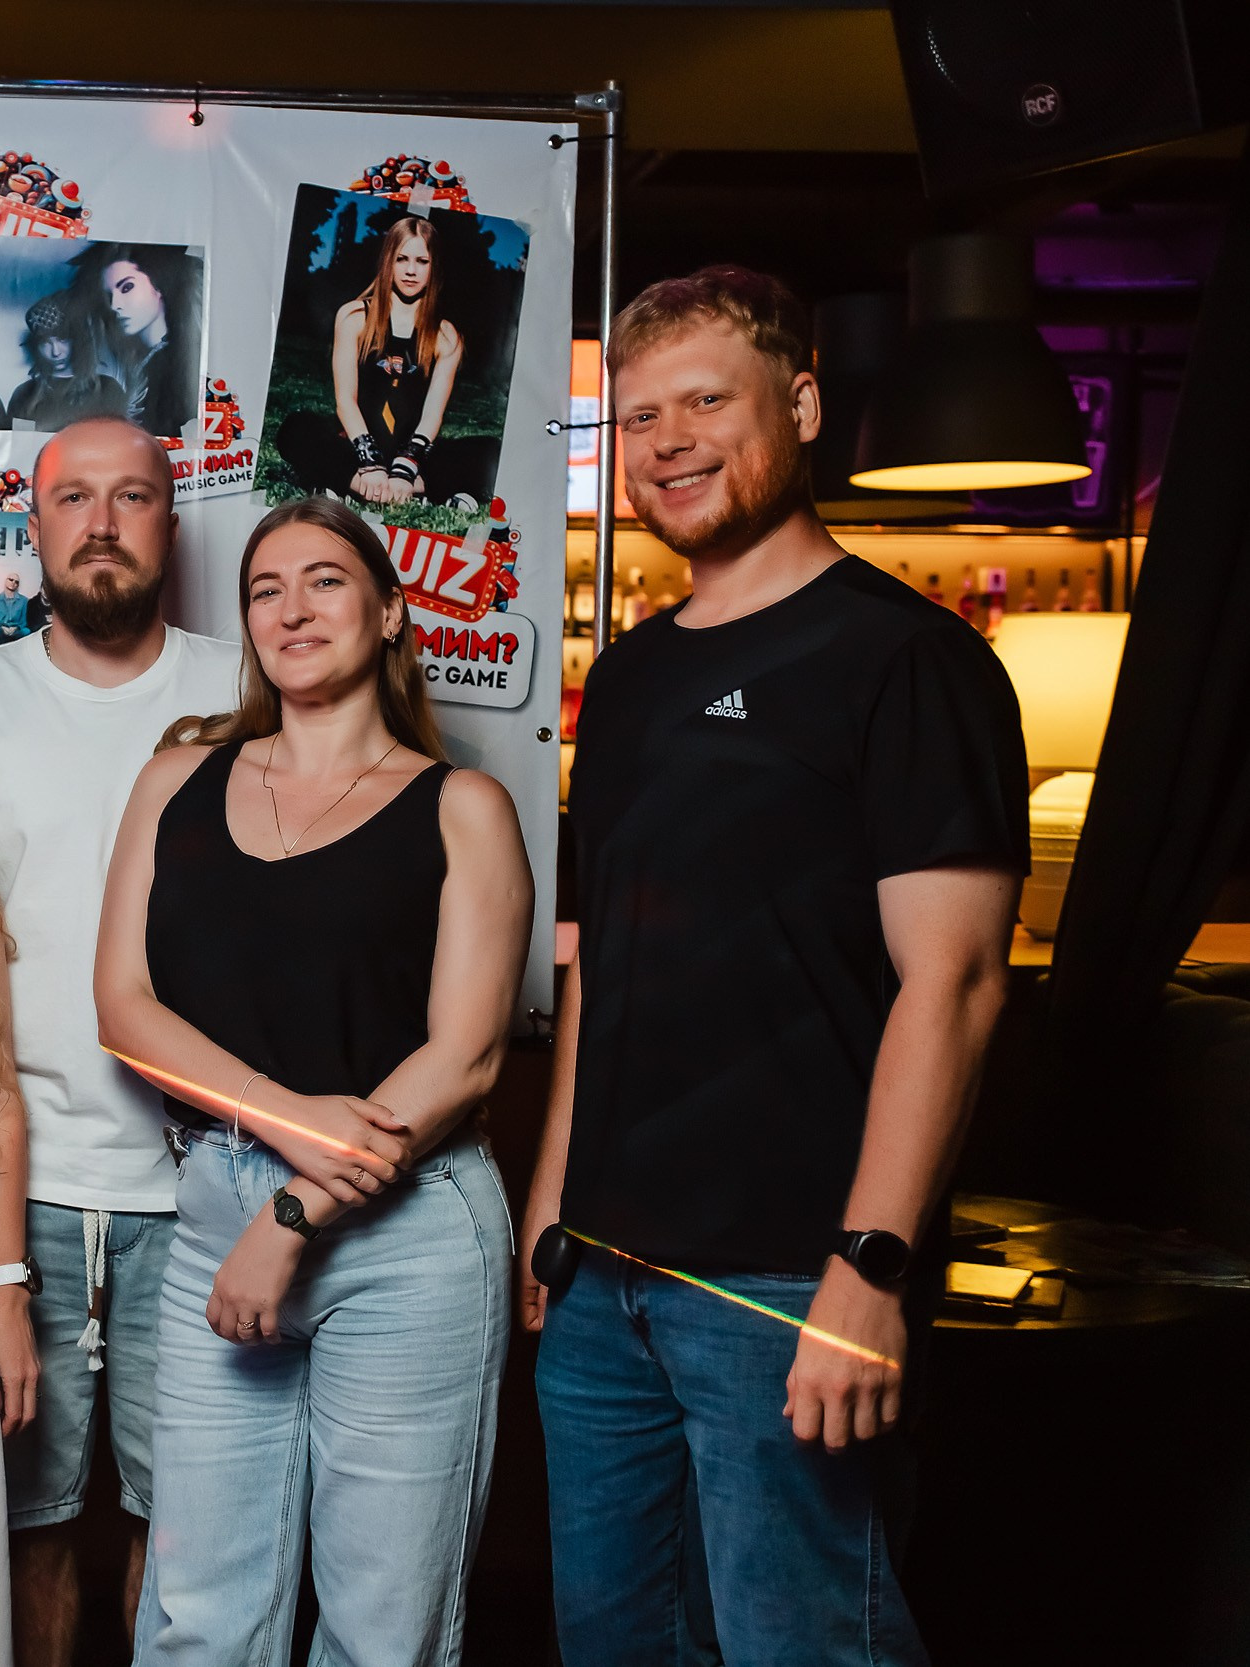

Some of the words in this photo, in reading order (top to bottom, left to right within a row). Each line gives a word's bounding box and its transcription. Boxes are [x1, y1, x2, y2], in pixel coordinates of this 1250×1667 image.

[1025, 94, 1055, 116] RCF
[177, 476, 216, 493] MUSIC
[219, 470, 253, 485] GAME
[445, 666, 508, 690] GAME
[705, 705, 748, 720] adidas
